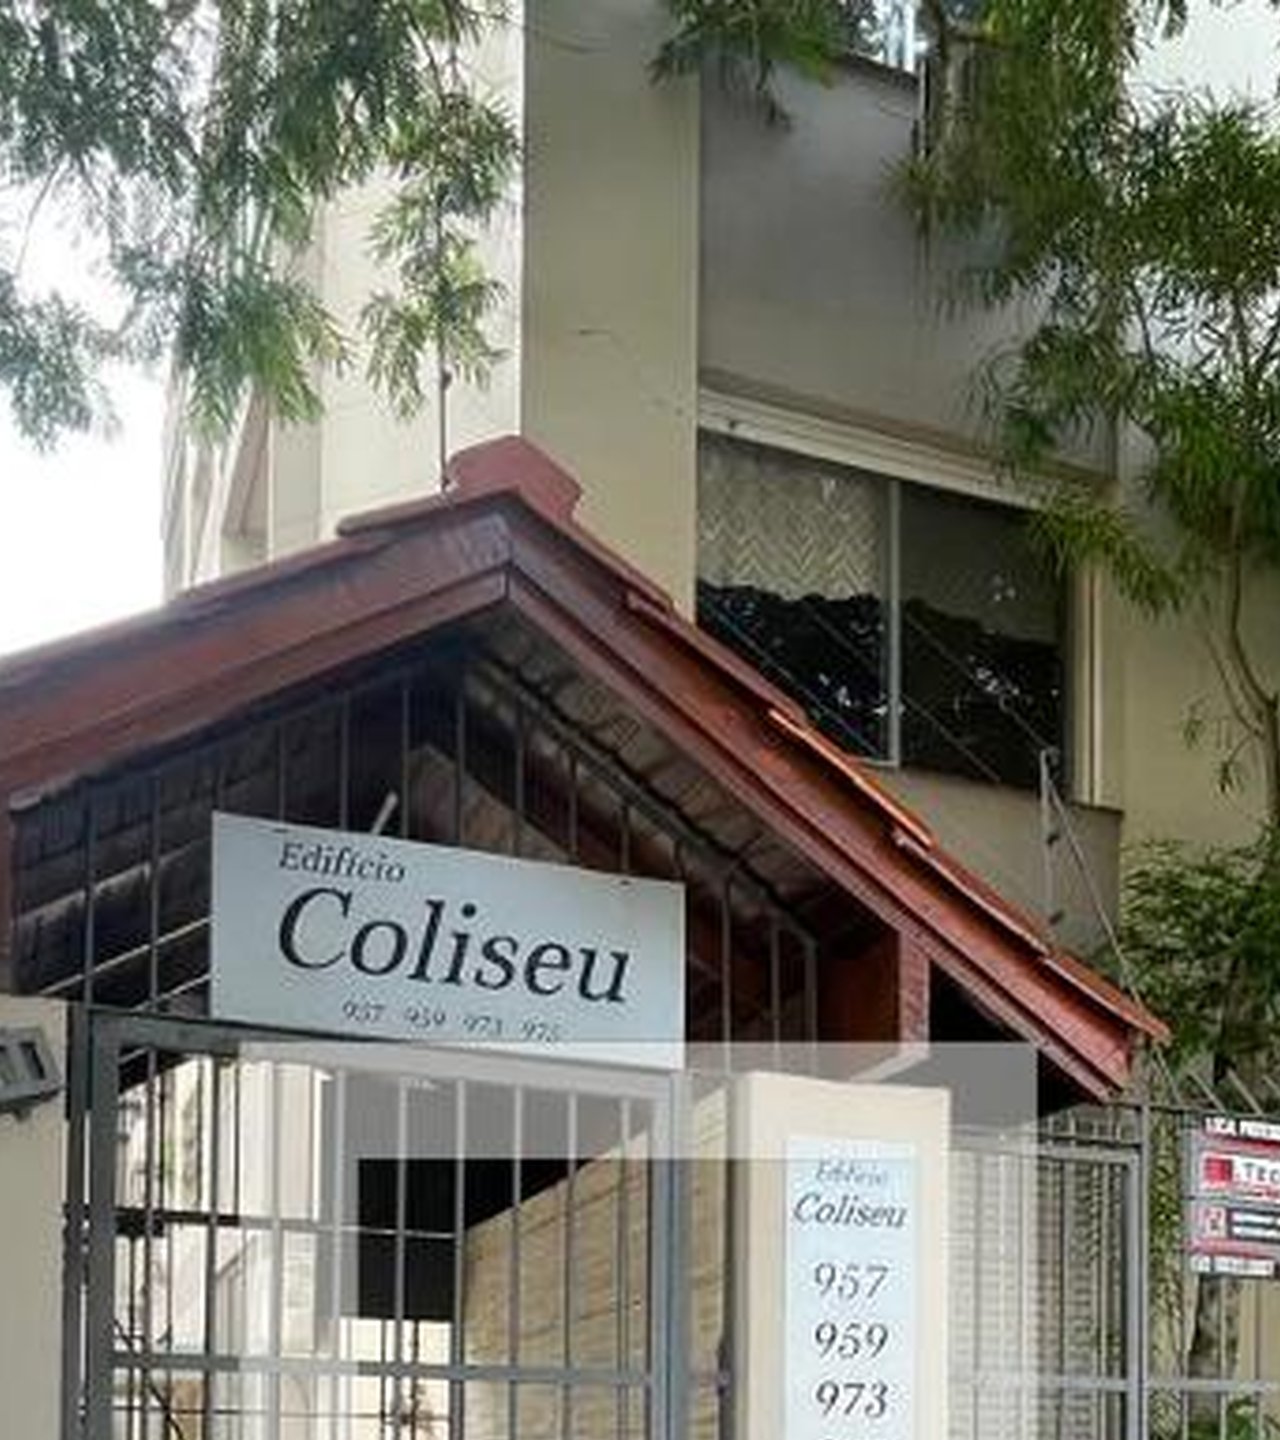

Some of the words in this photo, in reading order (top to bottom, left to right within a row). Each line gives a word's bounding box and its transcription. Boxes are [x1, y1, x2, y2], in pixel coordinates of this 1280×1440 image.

[278, 886, 631, 1004] Coliseu
[342, 1000, 386, 1023] 957
[404, 1006, 447, 1030] 959
[793, 1193, 908, 1229] Coliseu
[814, 1261, 890, 1300] 957
[814, 1321, 889, 1360] 959
[815, 1379, 889, 1419] 973
